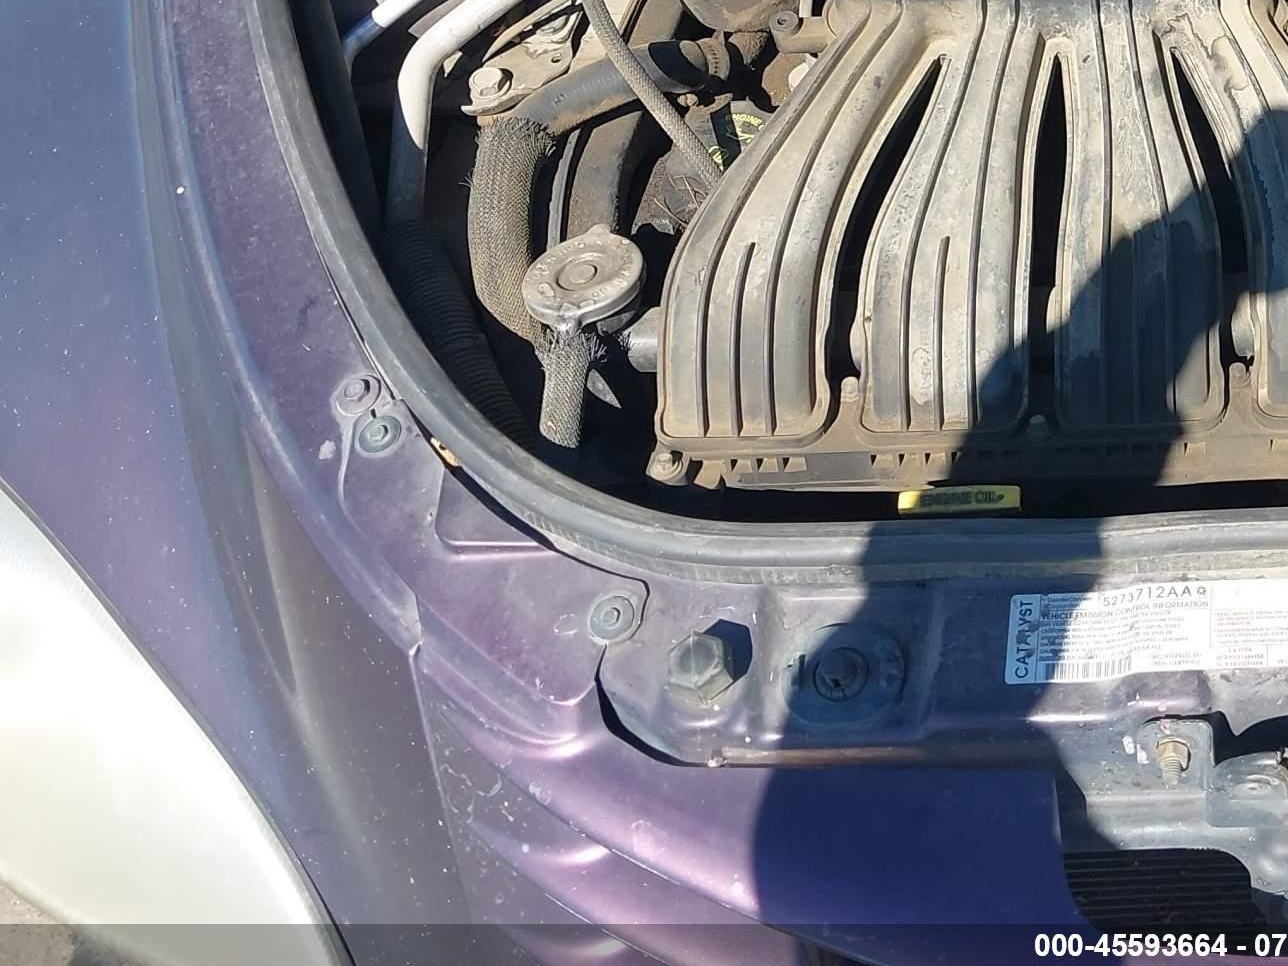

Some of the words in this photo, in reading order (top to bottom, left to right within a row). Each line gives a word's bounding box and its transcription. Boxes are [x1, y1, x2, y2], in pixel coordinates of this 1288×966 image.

[1103, 585, 1192, 607] 5273712AA
[1041, 611, 1074, 620] VEHICLE
[1075, 609, 1114, 620] EMISSION
[1152, 600, 1209, 611] INFORMATION
[1014, 600, 1034, 679] CATALYST
